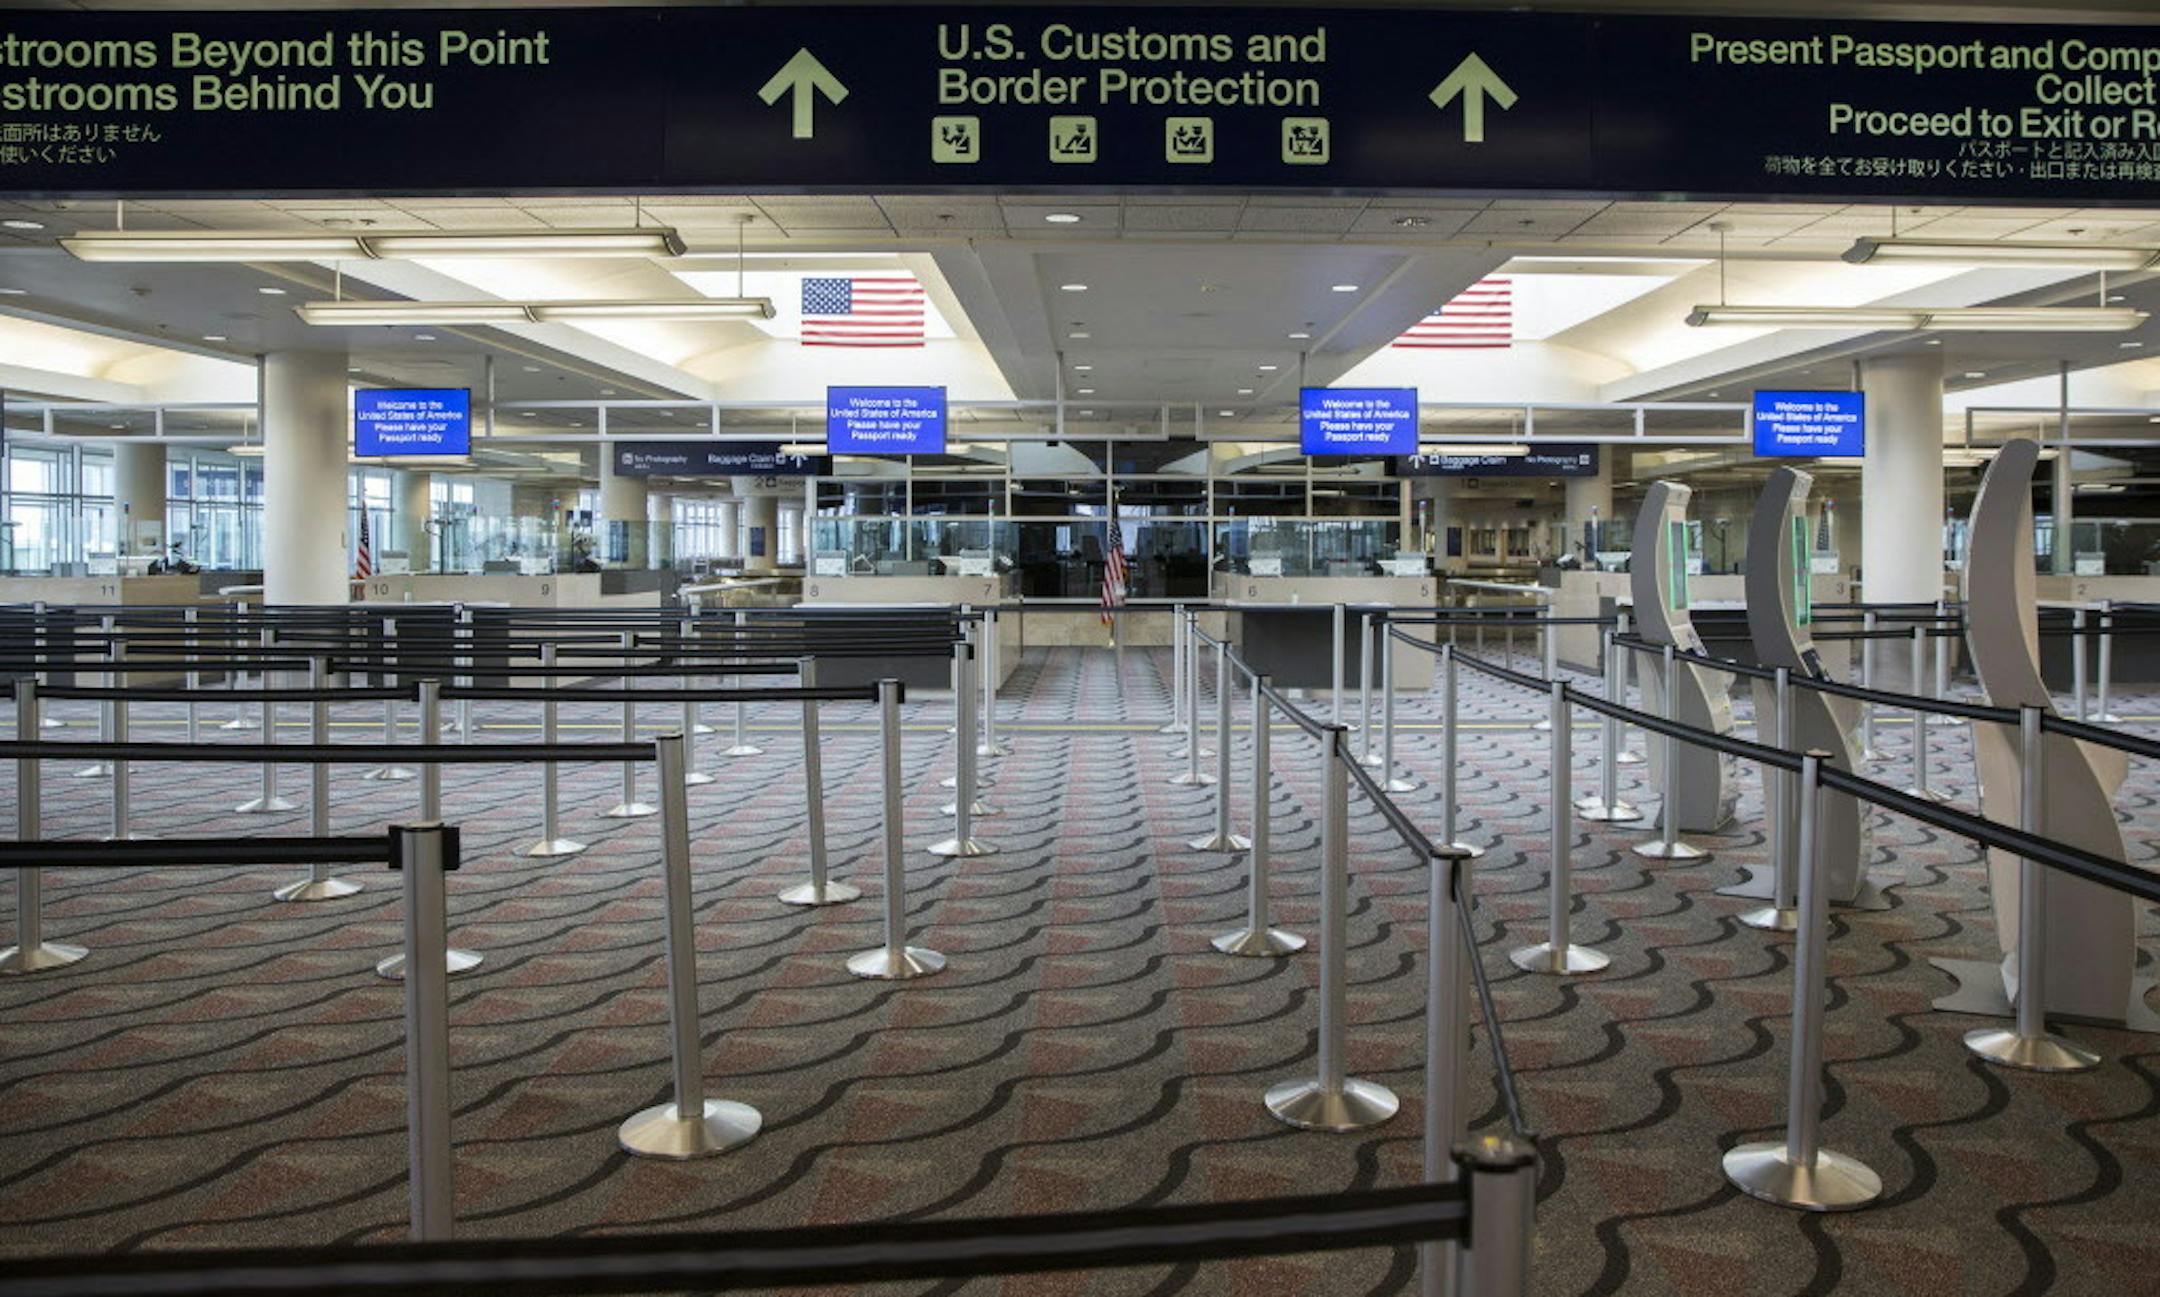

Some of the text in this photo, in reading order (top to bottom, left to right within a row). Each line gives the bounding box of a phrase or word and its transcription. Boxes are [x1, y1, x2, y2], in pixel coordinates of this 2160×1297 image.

[939, 24, 1326, 62] U.S. Customs and
[0, 30, 549, 76] trooms Beyond this Point
[1690, 32, 1823, 65] Present
[1831, 34, 1985, 75] Passport
[1990, 39, 2054, 71] and
[193, 75, 340, 111] Behind
[355, 74, 433, 109] You
[939, 68, 1320, 106] Border Protection
[2036, 72, 2157, 106] Collect
[1829, 103, 1972, 137] Proceed
[1978, 108, 2014, 138] to
[2020, 107, 2085, 138] Exit
[2089, 115, 2128, 138] or
[0, 123, 161, 142] 面所はありません
[419, 402, 427, 410] to
[429, 402, 444, 410] the
[892, 399, 901, 408] to
[903, 398, 918, 408] the
[1365, 400, 1374, 409] to
[1376, 400, 1391, 409] the
[1815, 403, 1823, 412] to
[1825, 402, 1839, 412] the
[416, 411, 425, 420] of
[890, 408, 900, 418] of
[1363, 410, 1372, 419] of
[1814, 412, 1822, 422] of
[375, 422, 448, 433] Please have your
[848, 420, 922, 431] Please have your
[1320, 421, 1394, 432] Please have your
[1773, 423, 1842, 434] Please have your
[379, 433, 443, 443] Passport ready
[851, 431, 917, 441] Passport ready
[1325, 431, 1390, 442] Passport ready
[1777, 433, 1838, 445] Passport ready
[1440, 455, 1507, 466] Baggage Claim
[101, 585, 115, 596] 11
[373, 584, 389, 595] 10
[541, 584, 550, 596] 9
[809, 585, 819, 597] 8
[983, 584, 992, 596] 7
[1248, 586, 1257, 598] 6
[1421, 585, 1429, 597] 5
[1836, 583, 1845, 595] 3
[2077, 584, 2086, 595] 2
